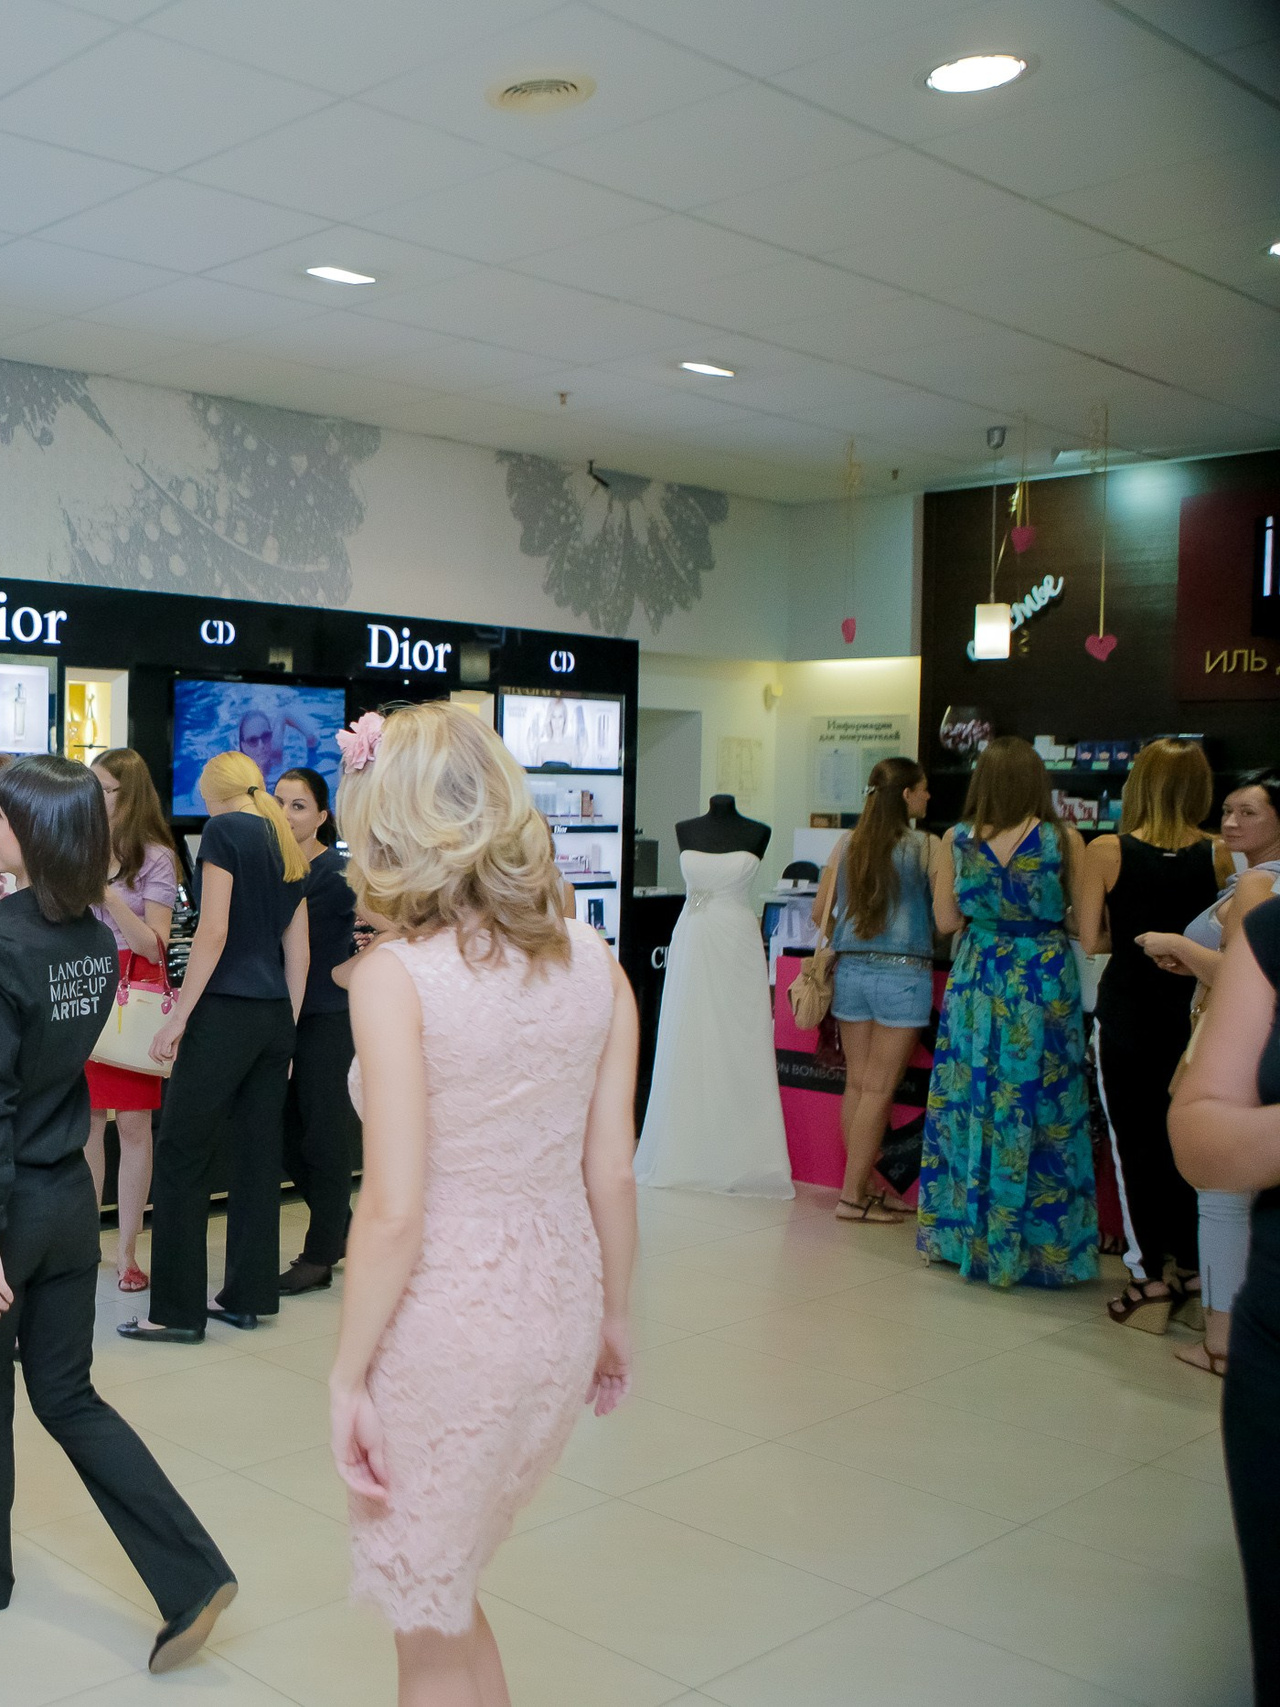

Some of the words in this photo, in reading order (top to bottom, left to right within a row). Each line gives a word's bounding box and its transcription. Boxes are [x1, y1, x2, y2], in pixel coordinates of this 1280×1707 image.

[365, 623, 452, 673] Dior
[1205, 648, 1268, 674] ИЛЬ
[49, 955, 114, 983] LANCÔME
[50, 976, 107, 1003] MAKE-UP
[51, 996, 100, 1022] ARTIST
